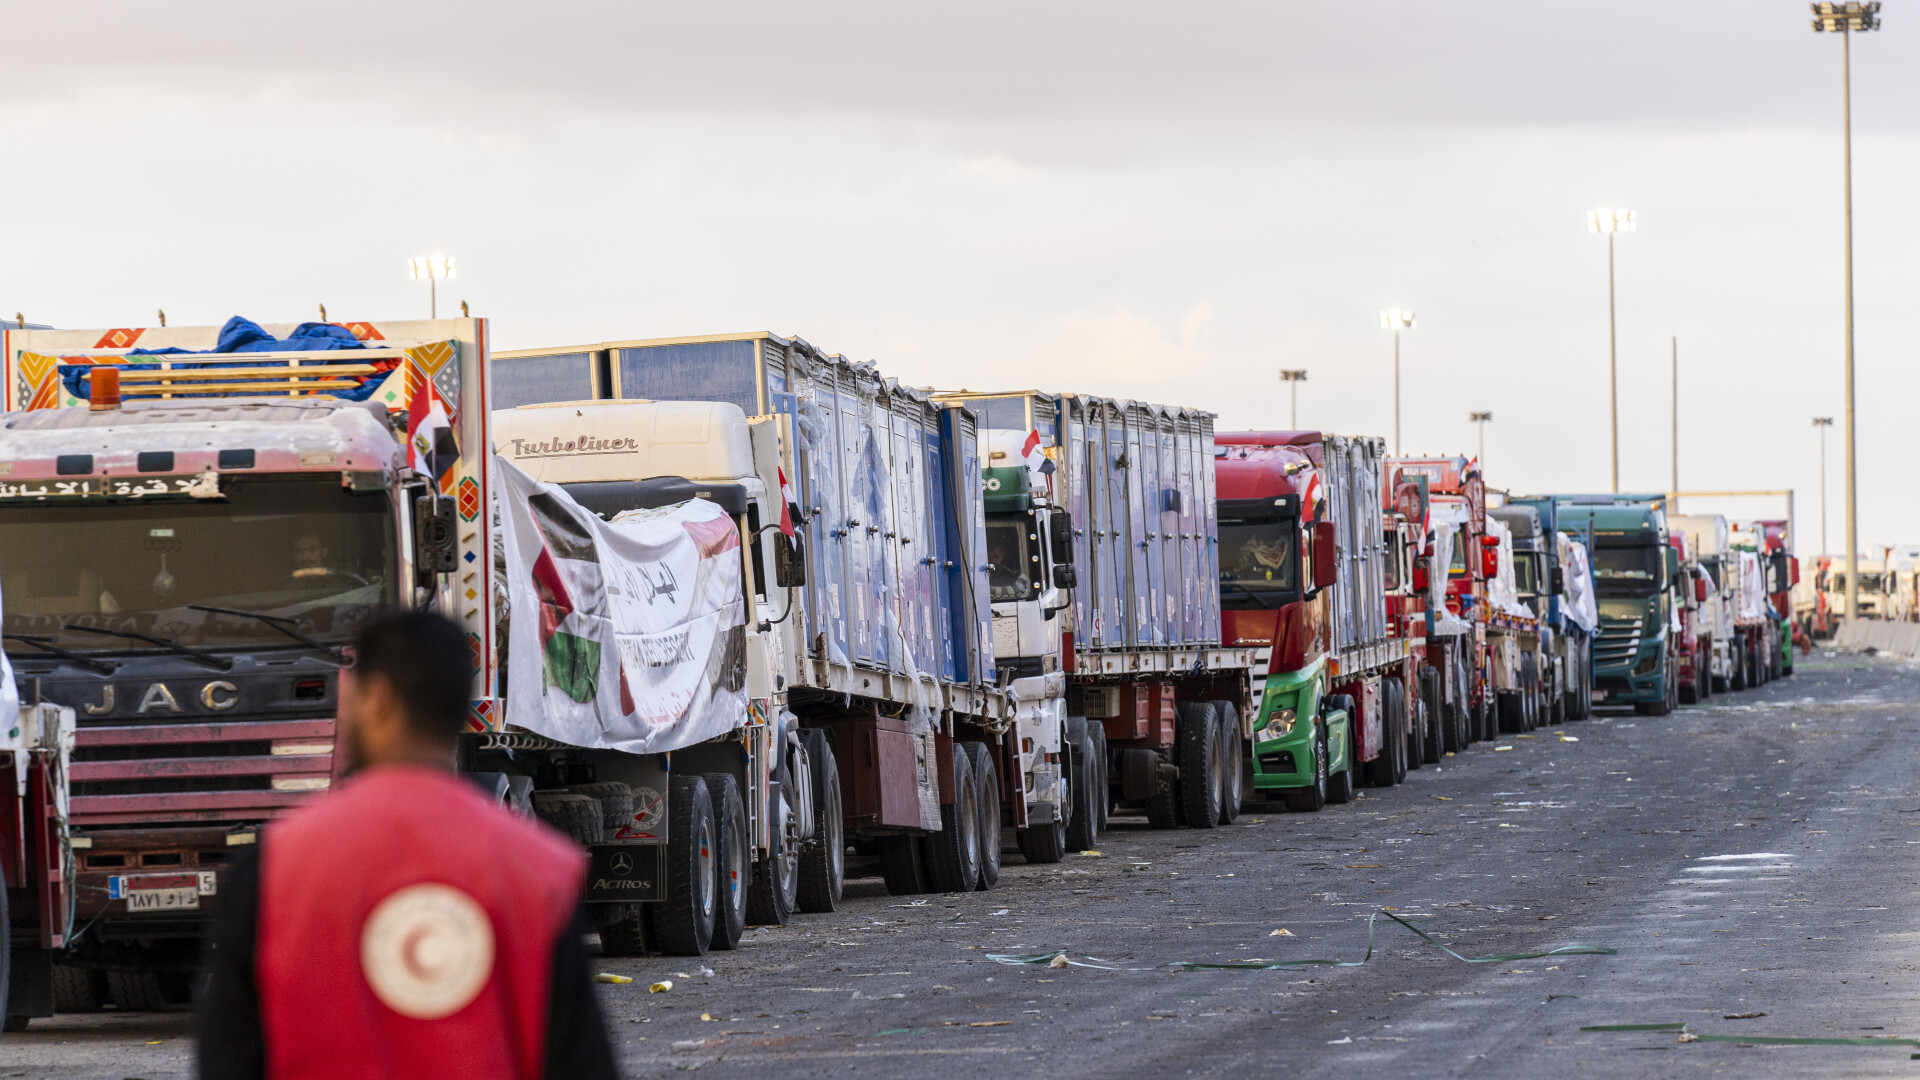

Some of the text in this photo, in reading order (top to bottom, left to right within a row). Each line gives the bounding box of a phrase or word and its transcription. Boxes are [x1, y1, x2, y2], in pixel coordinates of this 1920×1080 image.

[510, 435, 639, 456] Turboliner
[0, 481, 48, 500] بالل
[56, 481, 90, 497] إلا
[114, 479, 168, 498] قوة
[83, 680, 239, 714] JAC
